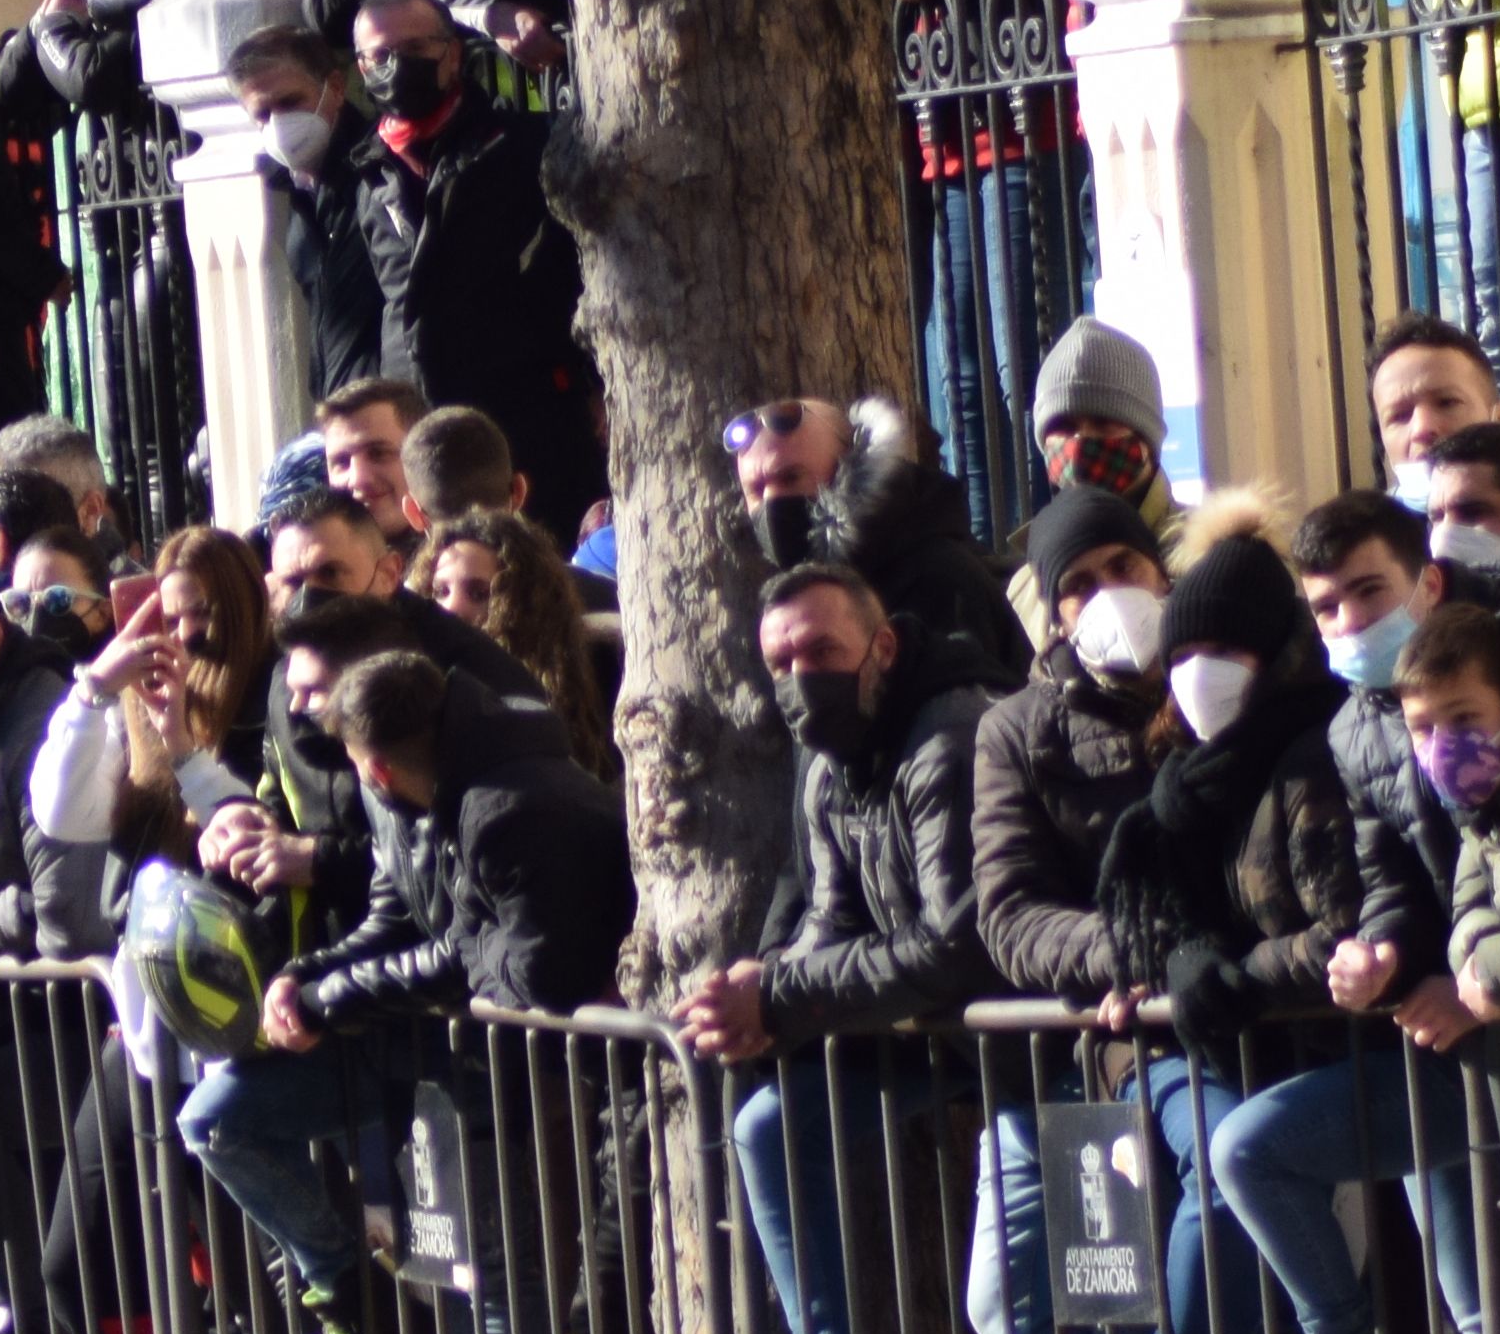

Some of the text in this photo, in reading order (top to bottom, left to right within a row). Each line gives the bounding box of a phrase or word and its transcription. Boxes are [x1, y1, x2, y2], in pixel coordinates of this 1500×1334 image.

[415, 1229, 456, 1259] ZAMORA
[1065, 1247, 1135, 1268] AYUNTAMIENTO
[1066, 1268, 1137, 1294] DE ZAMORA
